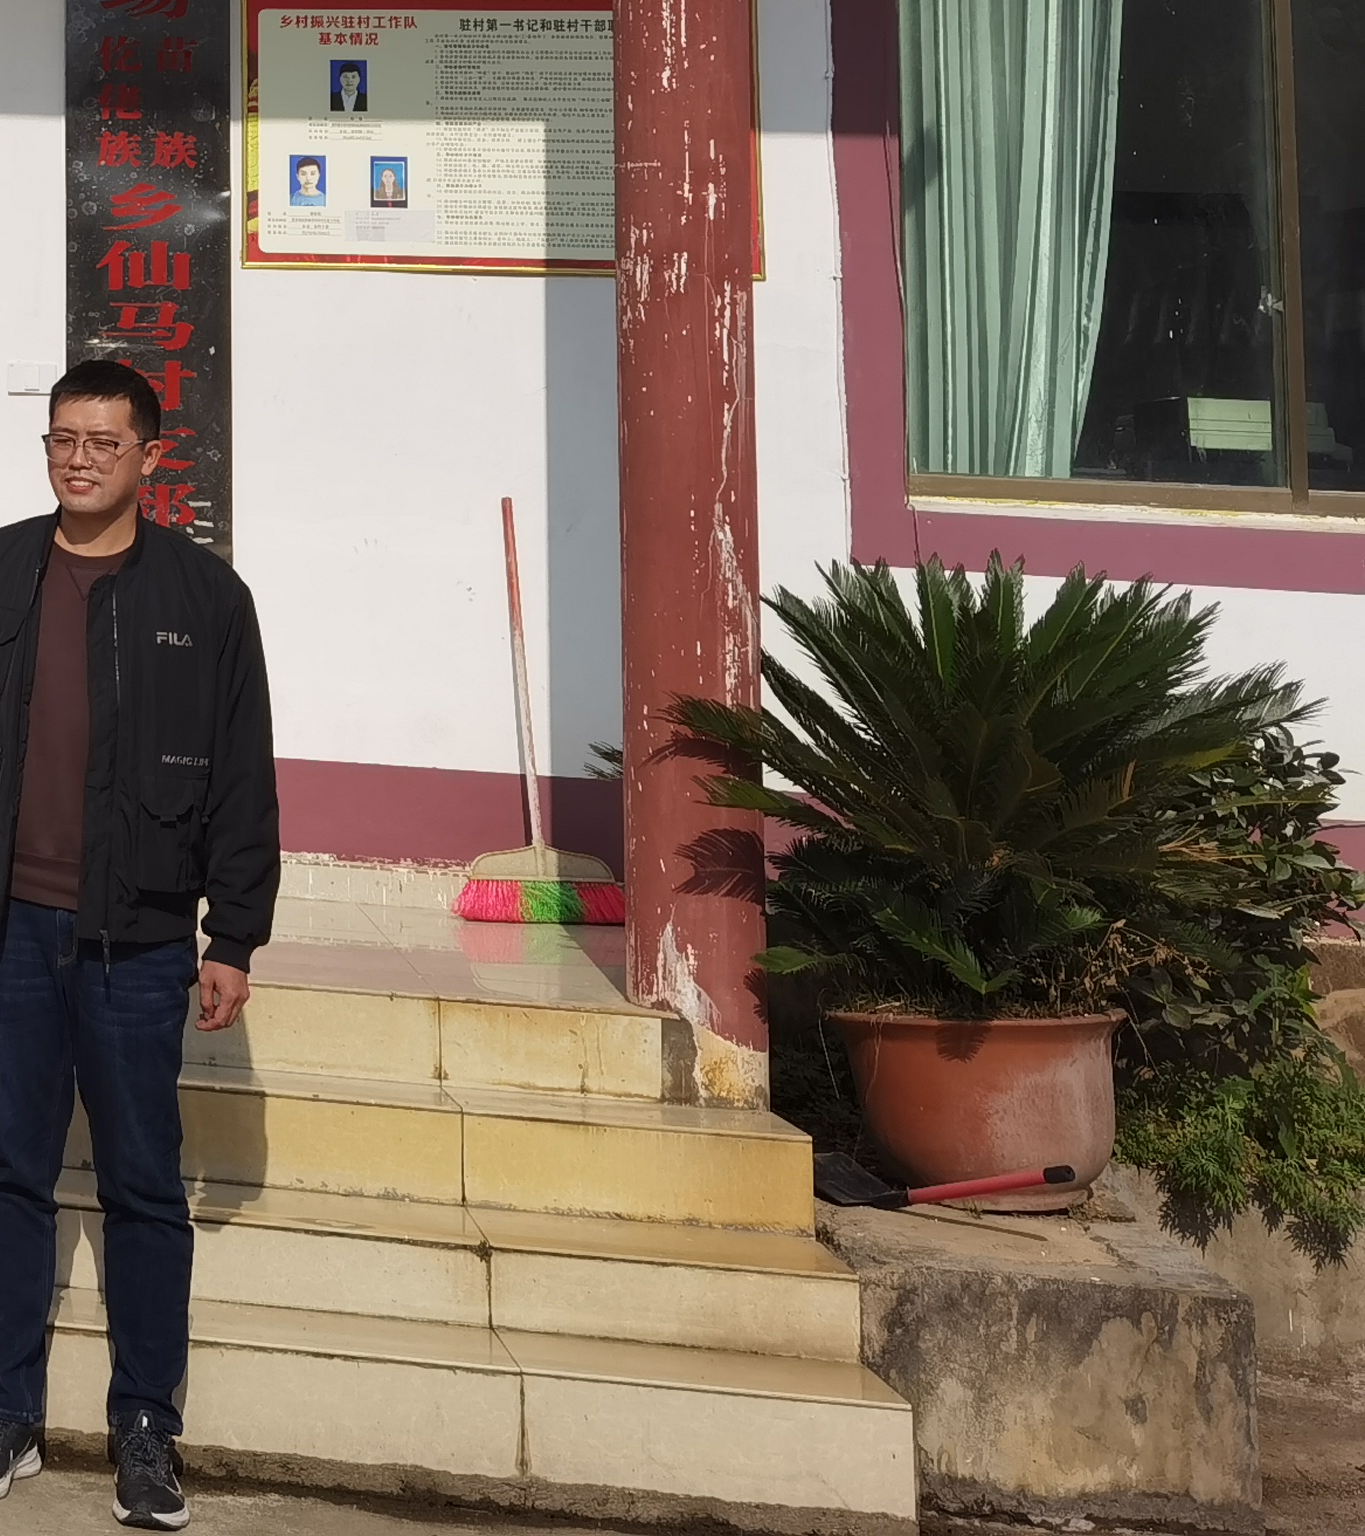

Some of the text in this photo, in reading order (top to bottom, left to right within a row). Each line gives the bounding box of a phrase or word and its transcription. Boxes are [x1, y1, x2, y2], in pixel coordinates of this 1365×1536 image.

[279, 15, 419, 29] 乡村振兴驻村工作队
[318, 32, 380, 47] 基本情况
[156, 631, 193, 647] FILA
